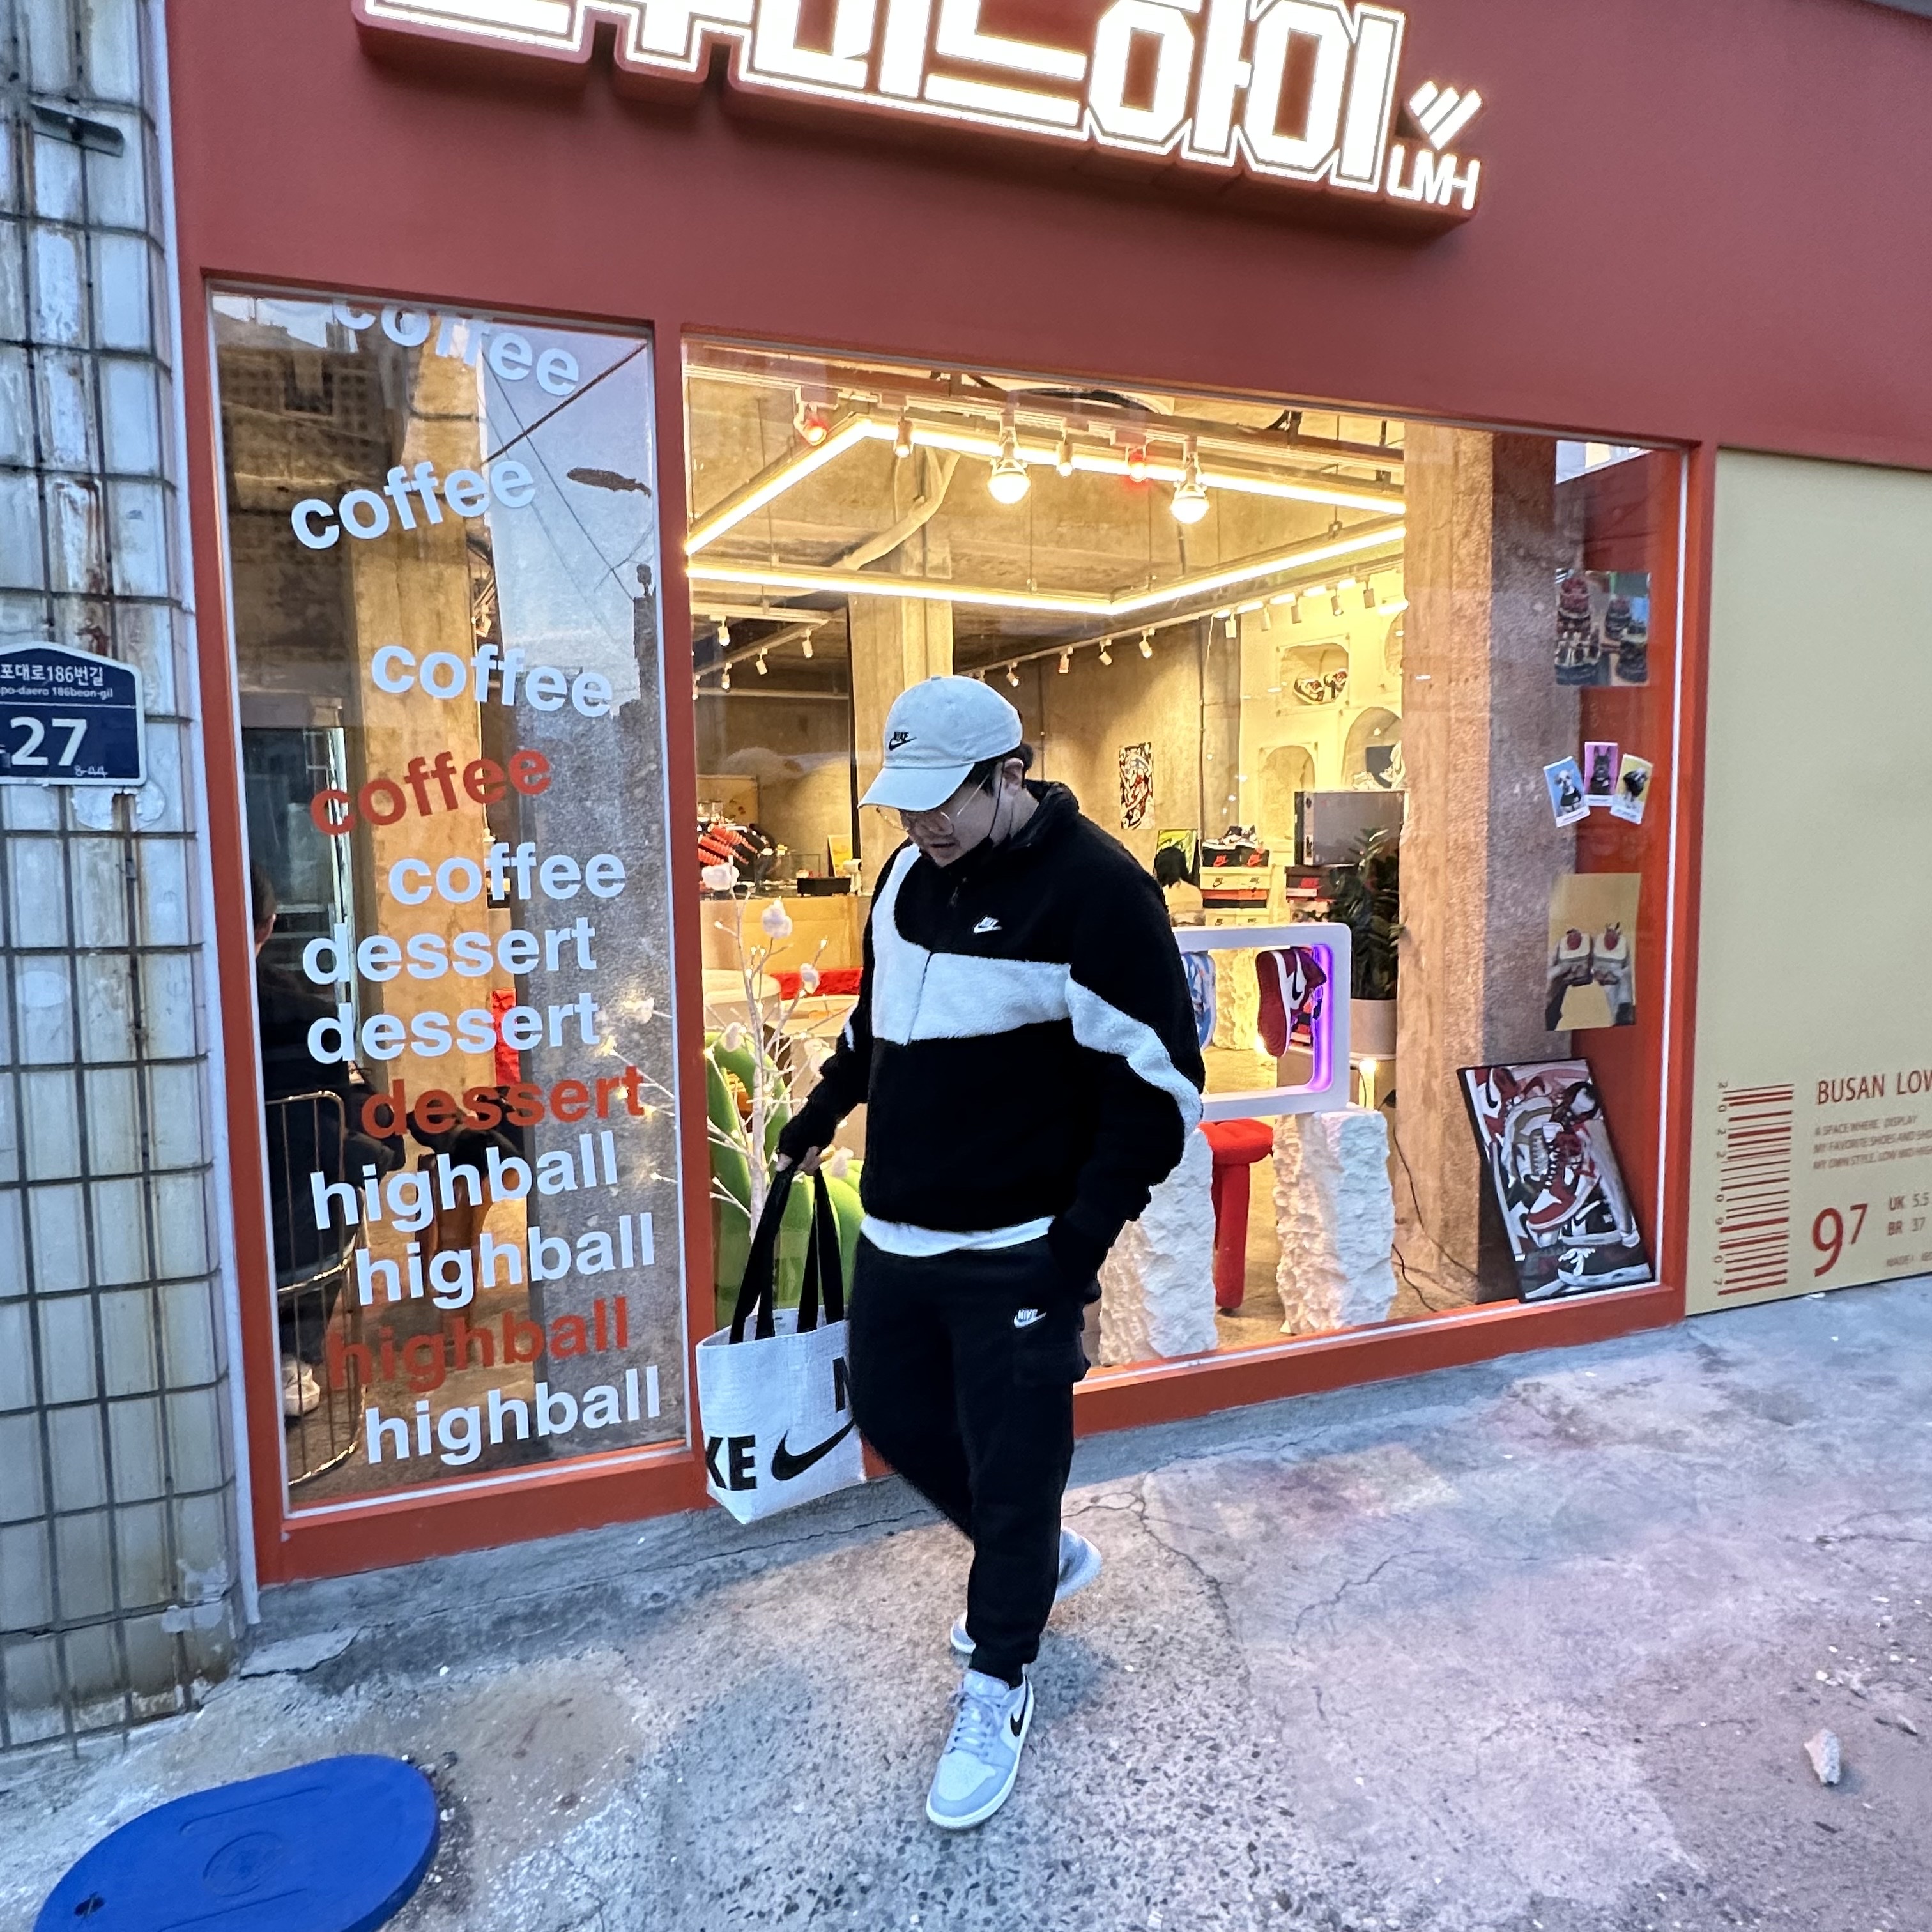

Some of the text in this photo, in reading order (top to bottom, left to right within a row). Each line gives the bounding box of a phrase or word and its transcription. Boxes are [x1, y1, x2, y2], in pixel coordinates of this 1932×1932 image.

[1387, 144, 1480, 210] LMH
[332, 299, 579, 397] coffee
[291, 461, 537, 549] coffee
[371, 643, 613, 717] coffee
[10, 716, 87, 766] 27
[310, 749, 552, 836] coffee
[388, 841, 627, 905] coffee
[302, 917, 597, 985] dessert
[307, 993, 601, 1064] dessert
[361, 1066, 645, 1139] dessert
[1816, 1073, 1885, 1105] BUSAN
[310, 1130, 618, 1233] highball
[1888, 1194, 1905, 1211] UK
[1911, 1216, 1926, 1232] 37
[355, 1212, 655, 1310] highball
[326, 1296, 629, 1393] highball
[365, 1365, 661, 1465] highball
